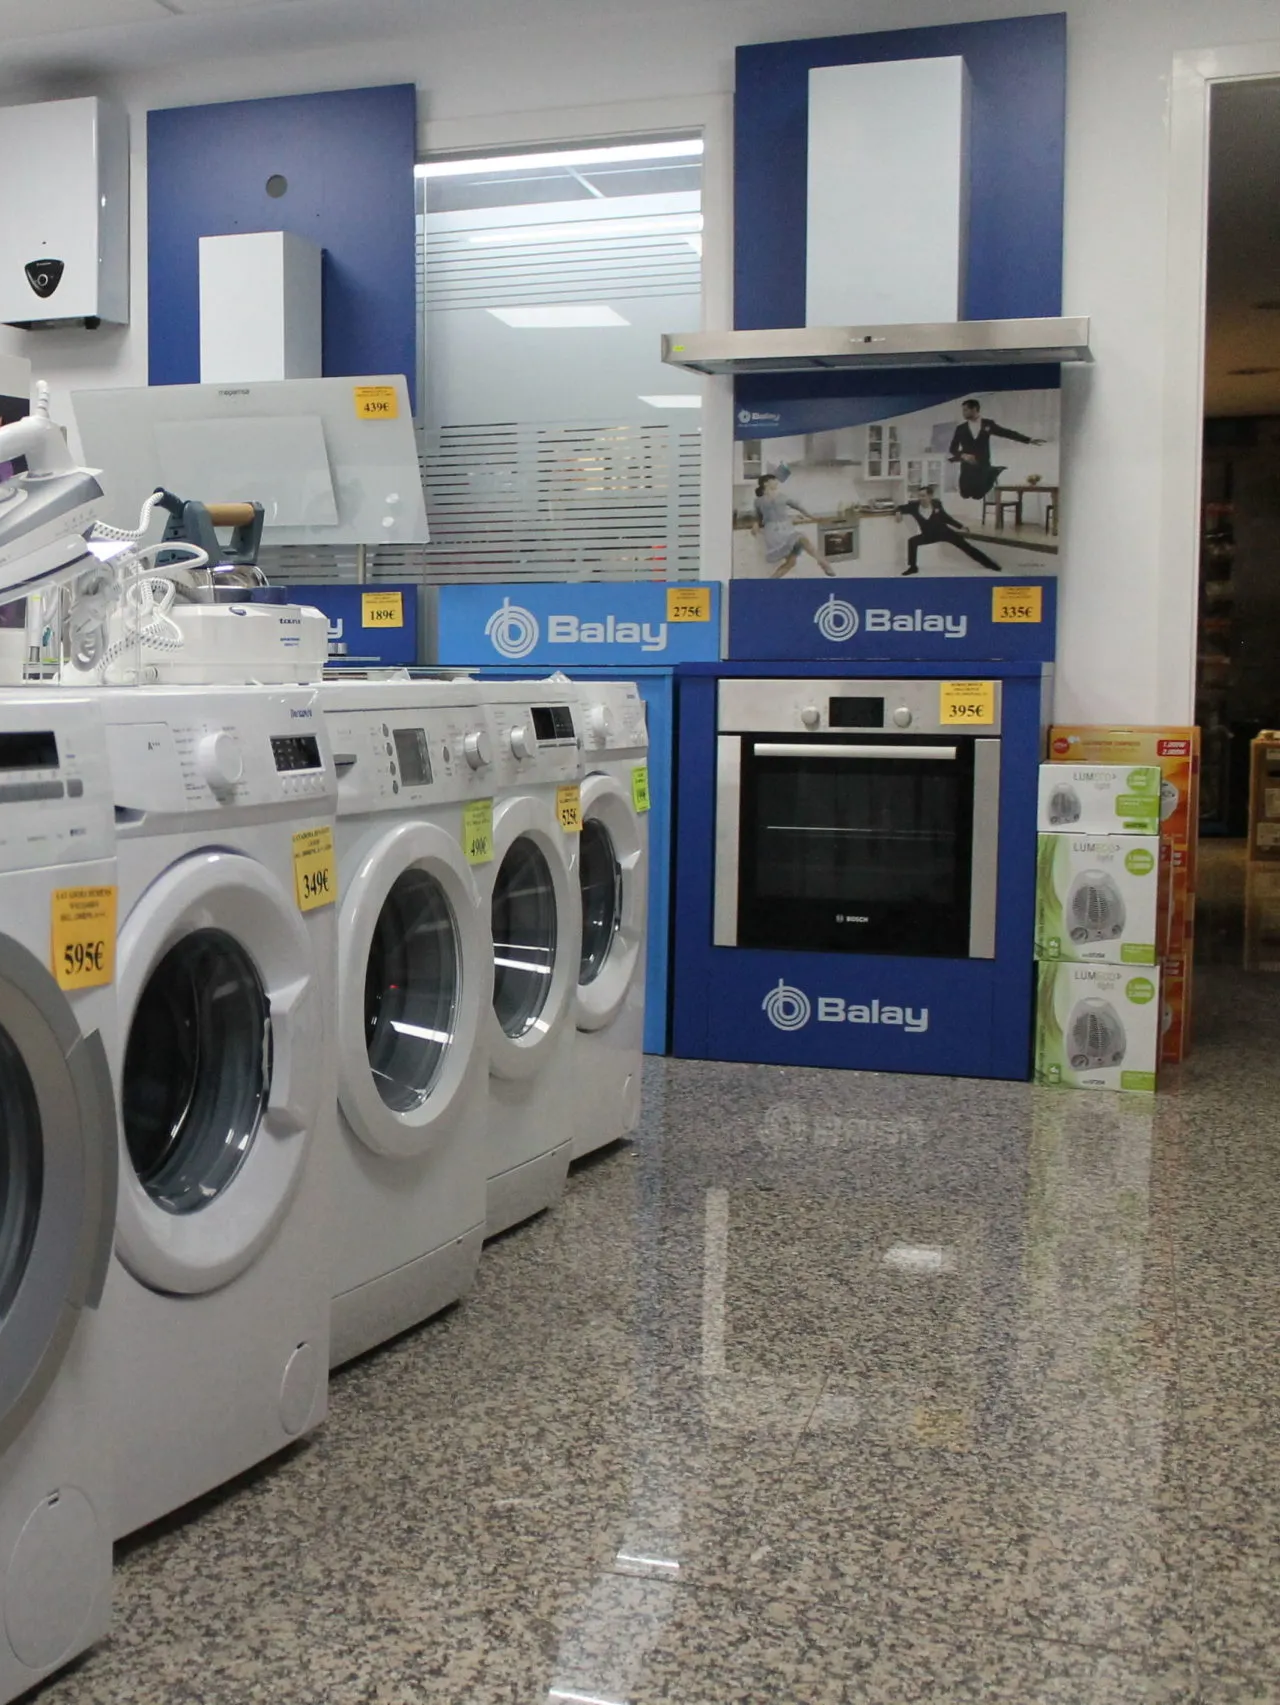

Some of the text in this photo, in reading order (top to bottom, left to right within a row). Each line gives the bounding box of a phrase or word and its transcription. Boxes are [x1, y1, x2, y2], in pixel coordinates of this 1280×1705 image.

[363, 401, 390, 413] 439€
[370, 609, 396, 621] 189€
[673, 606, 702, 618] 275€
[1000, 606, 1034, 619] 335€
[865, 608, 968, 638] Balay
[548, 614, 667, 651] Balay
[949, 703, 984, 718] 395€
[303, 868, 330, 899] 349€
[845, 915, 869, 923] BOSCH
[64, 940, 106, 976] 595€
[817, 996, 929, 1033] Balay
